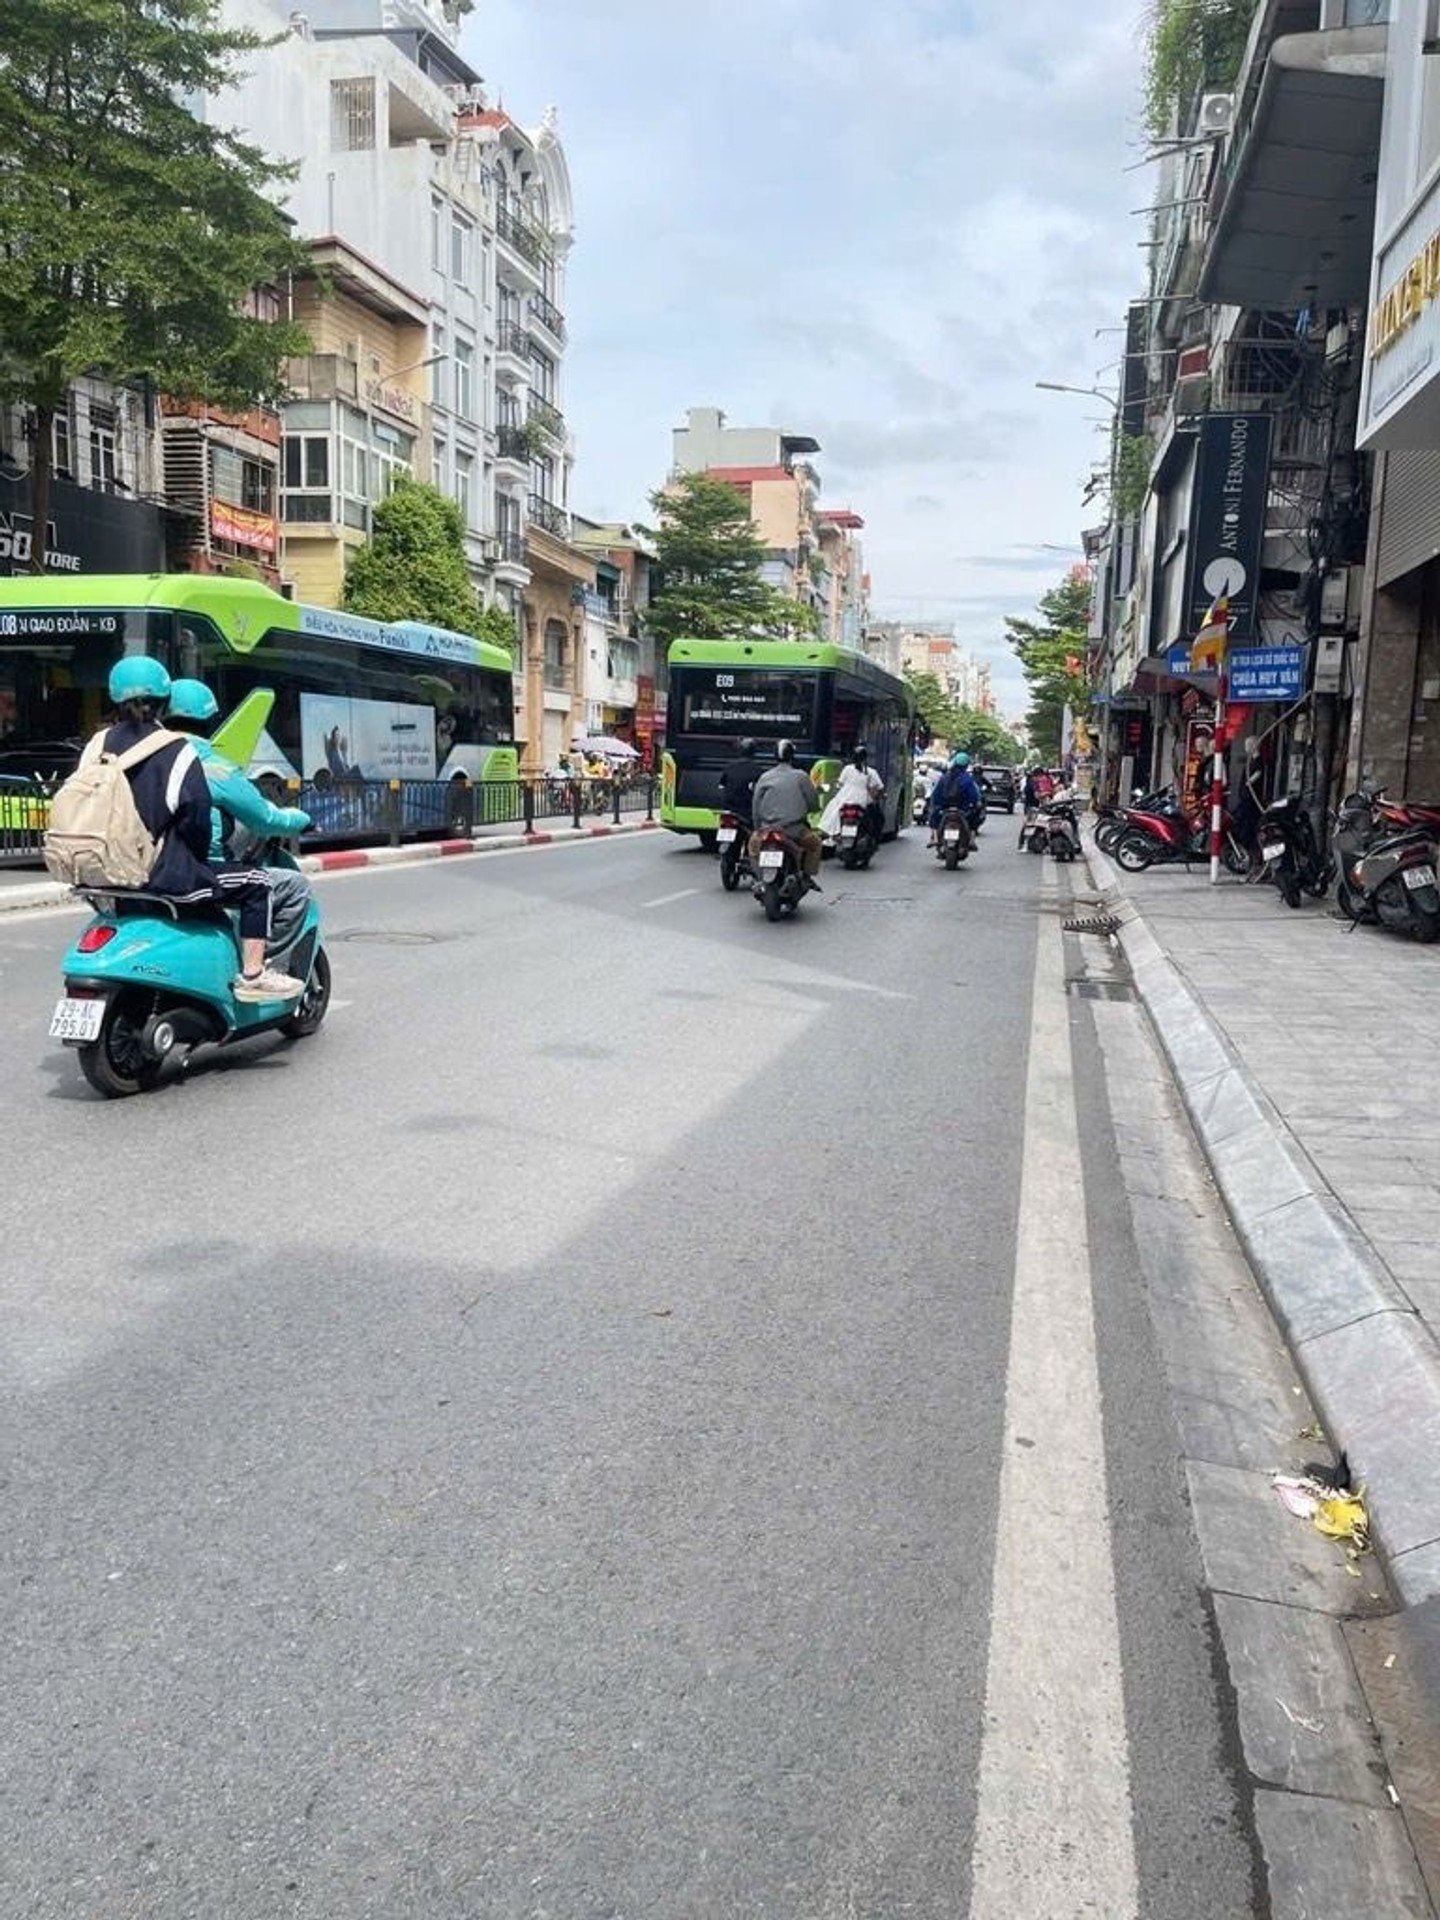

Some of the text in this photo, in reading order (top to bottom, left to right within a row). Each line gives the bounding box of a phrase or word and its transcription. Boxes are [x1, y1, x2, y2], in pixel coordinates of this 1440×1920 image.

[1223, 417, 1249, 493] FERNANDO
[43, 551, 82, 571] TORE
[0, 615, 17, 635] 08
